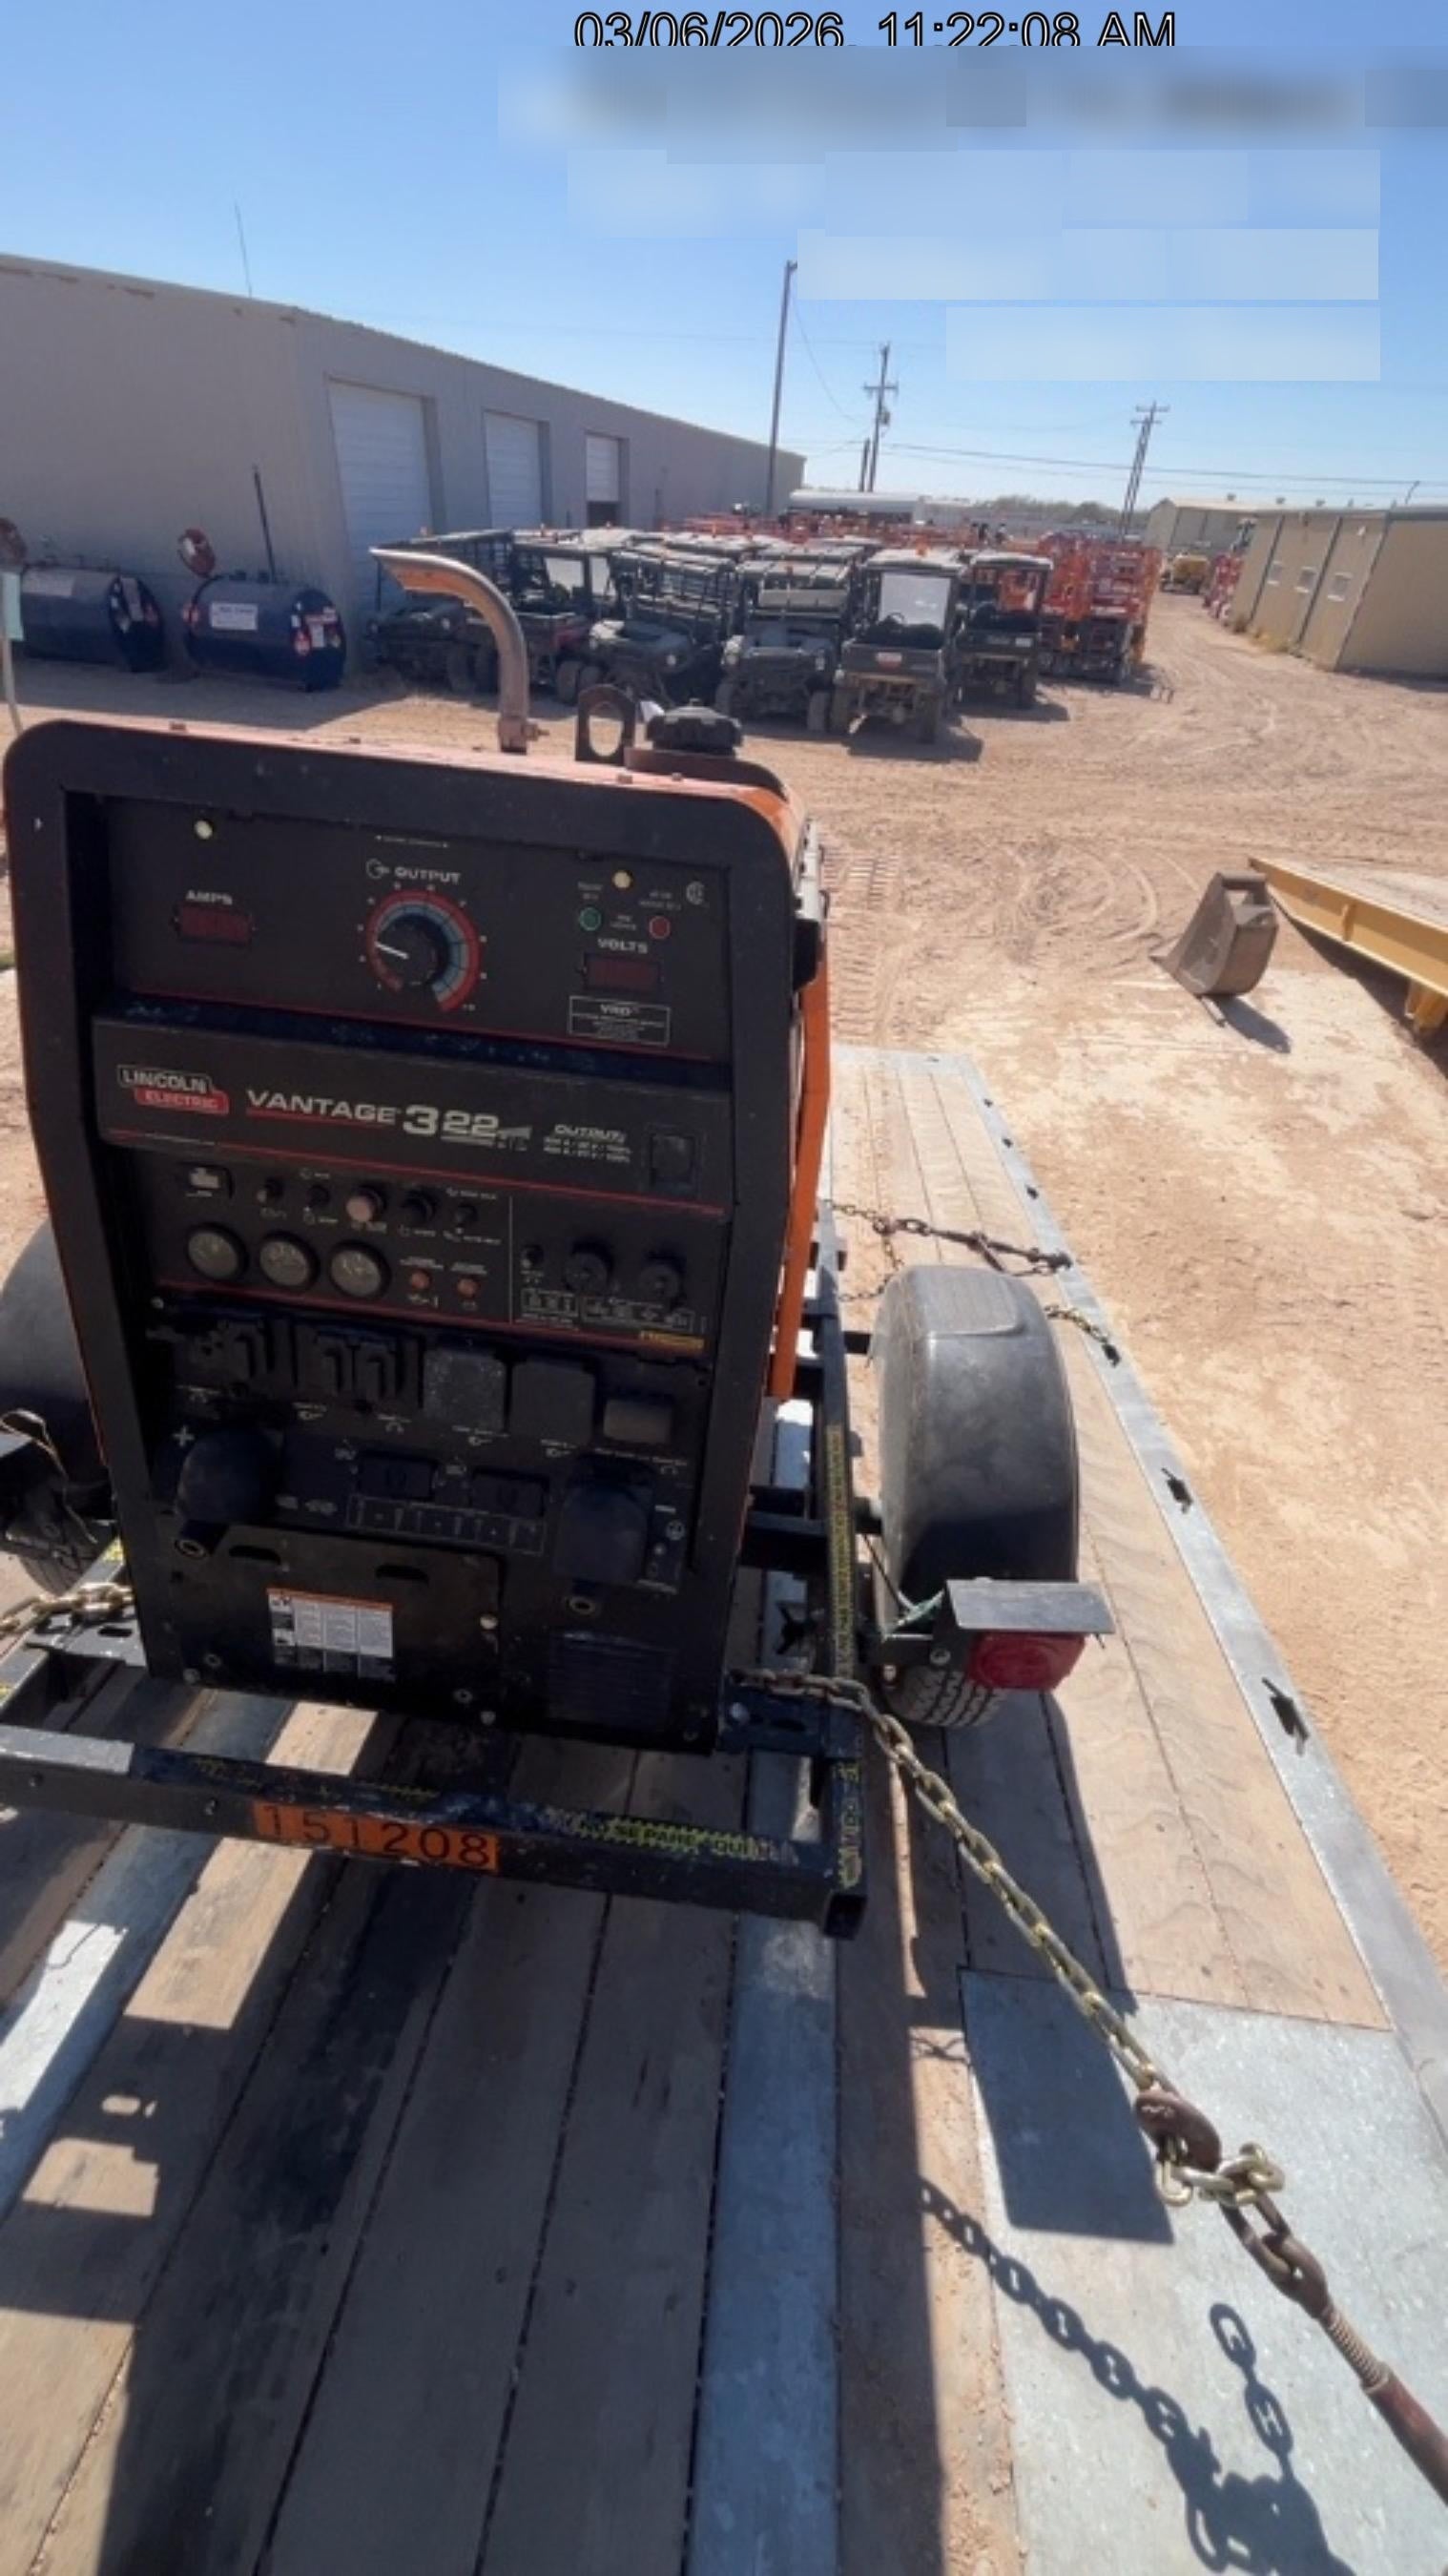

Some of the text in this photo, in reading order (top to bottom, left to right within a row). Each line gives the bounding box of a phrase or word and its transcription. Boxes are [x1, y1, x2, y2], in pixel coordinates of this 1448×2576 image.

[394, 866, 462, 885] OUTPUT
[185, 889, 233, 905] AMPS
[597, 938, 649, 954] VOLTS
[122, 1068, 207, 1094] LINCOLN
[145, 1090, 218, 1109] ELECTRIC
[246, 1090, 499, 1138] VANTAGE 322
[262, 1805, 490, 1867] 151208
